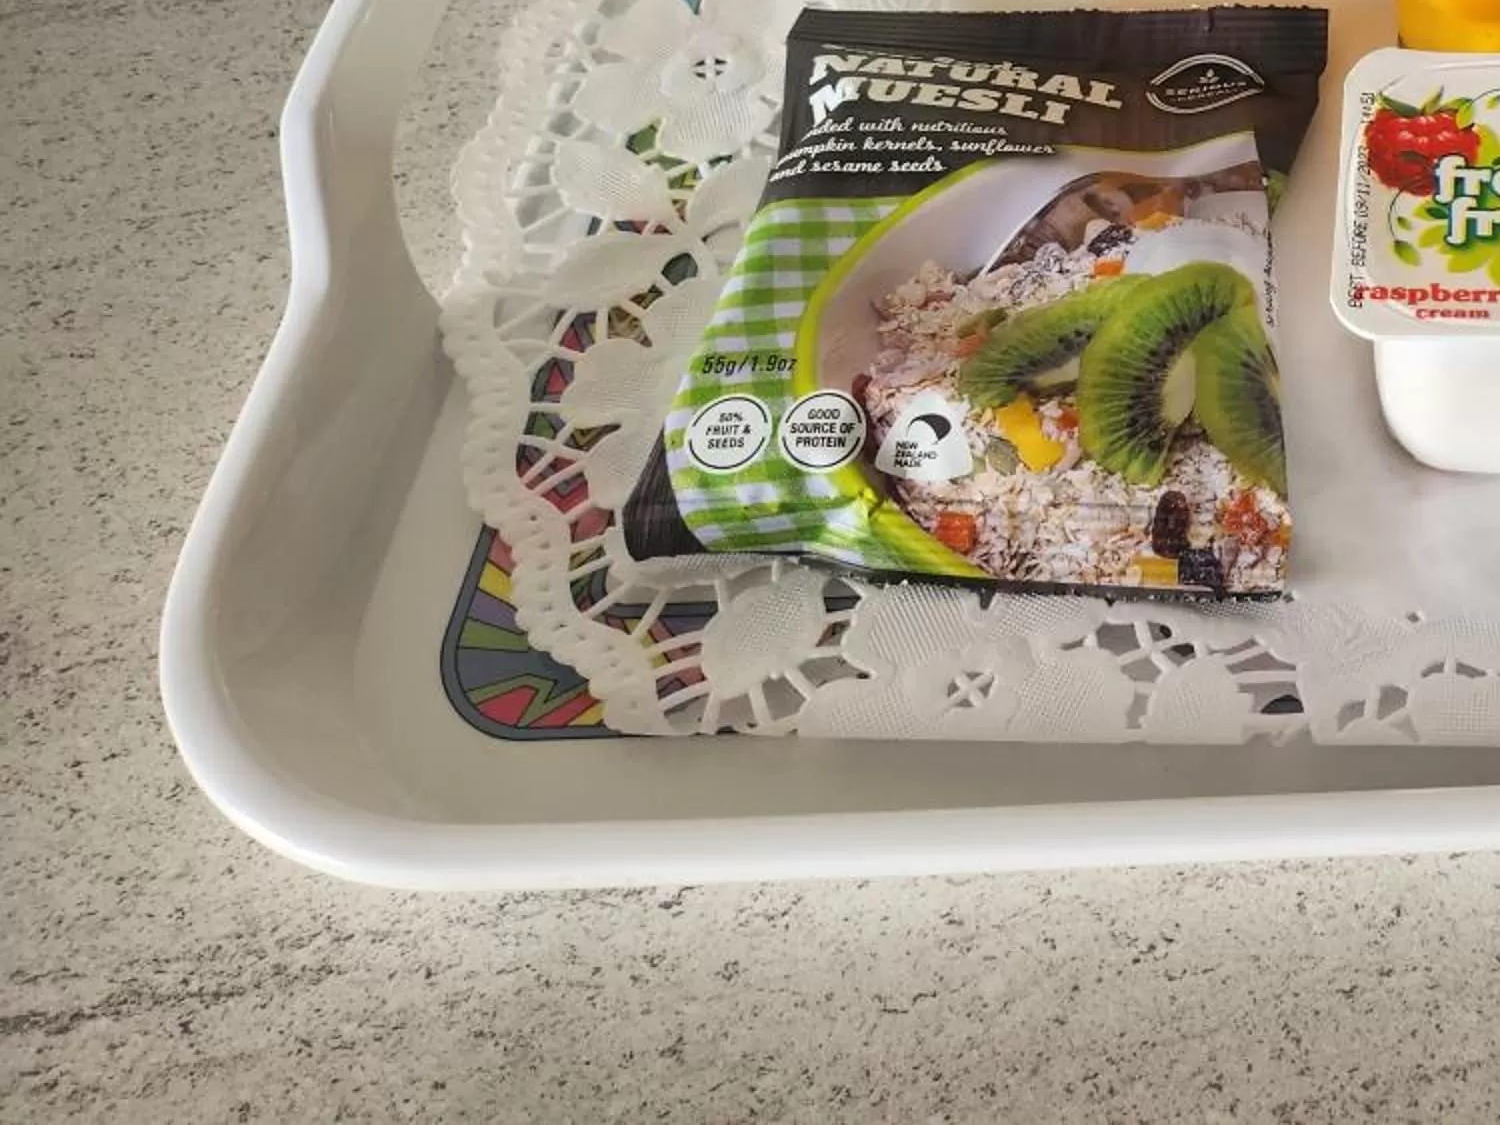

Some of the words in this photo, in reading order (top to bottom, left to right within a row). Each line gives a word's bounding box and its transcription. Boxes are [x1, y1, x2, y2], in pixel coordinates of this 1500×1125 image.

[809, 44, 1124, 110] NATURAL
[809, 76, 1071, 127] MUESLI
[859, 117, 905, 132] with
[863, 136, 943, 152] kernels,
[950, 138, 1056, 155] sunflower
[810, 159, 883, 172] sesame
[1415, 308, 1491, 320] cream
[808, 408, 841, 420] GOOD
[705, 425, 739, 436] FRUIT
[790, 424, 836, 435] SOURCE
[839, 423, 856, 434] OF
[707, 437, 745, 449] SEEDS
[795, 436, 847, 448] PROTEIN
